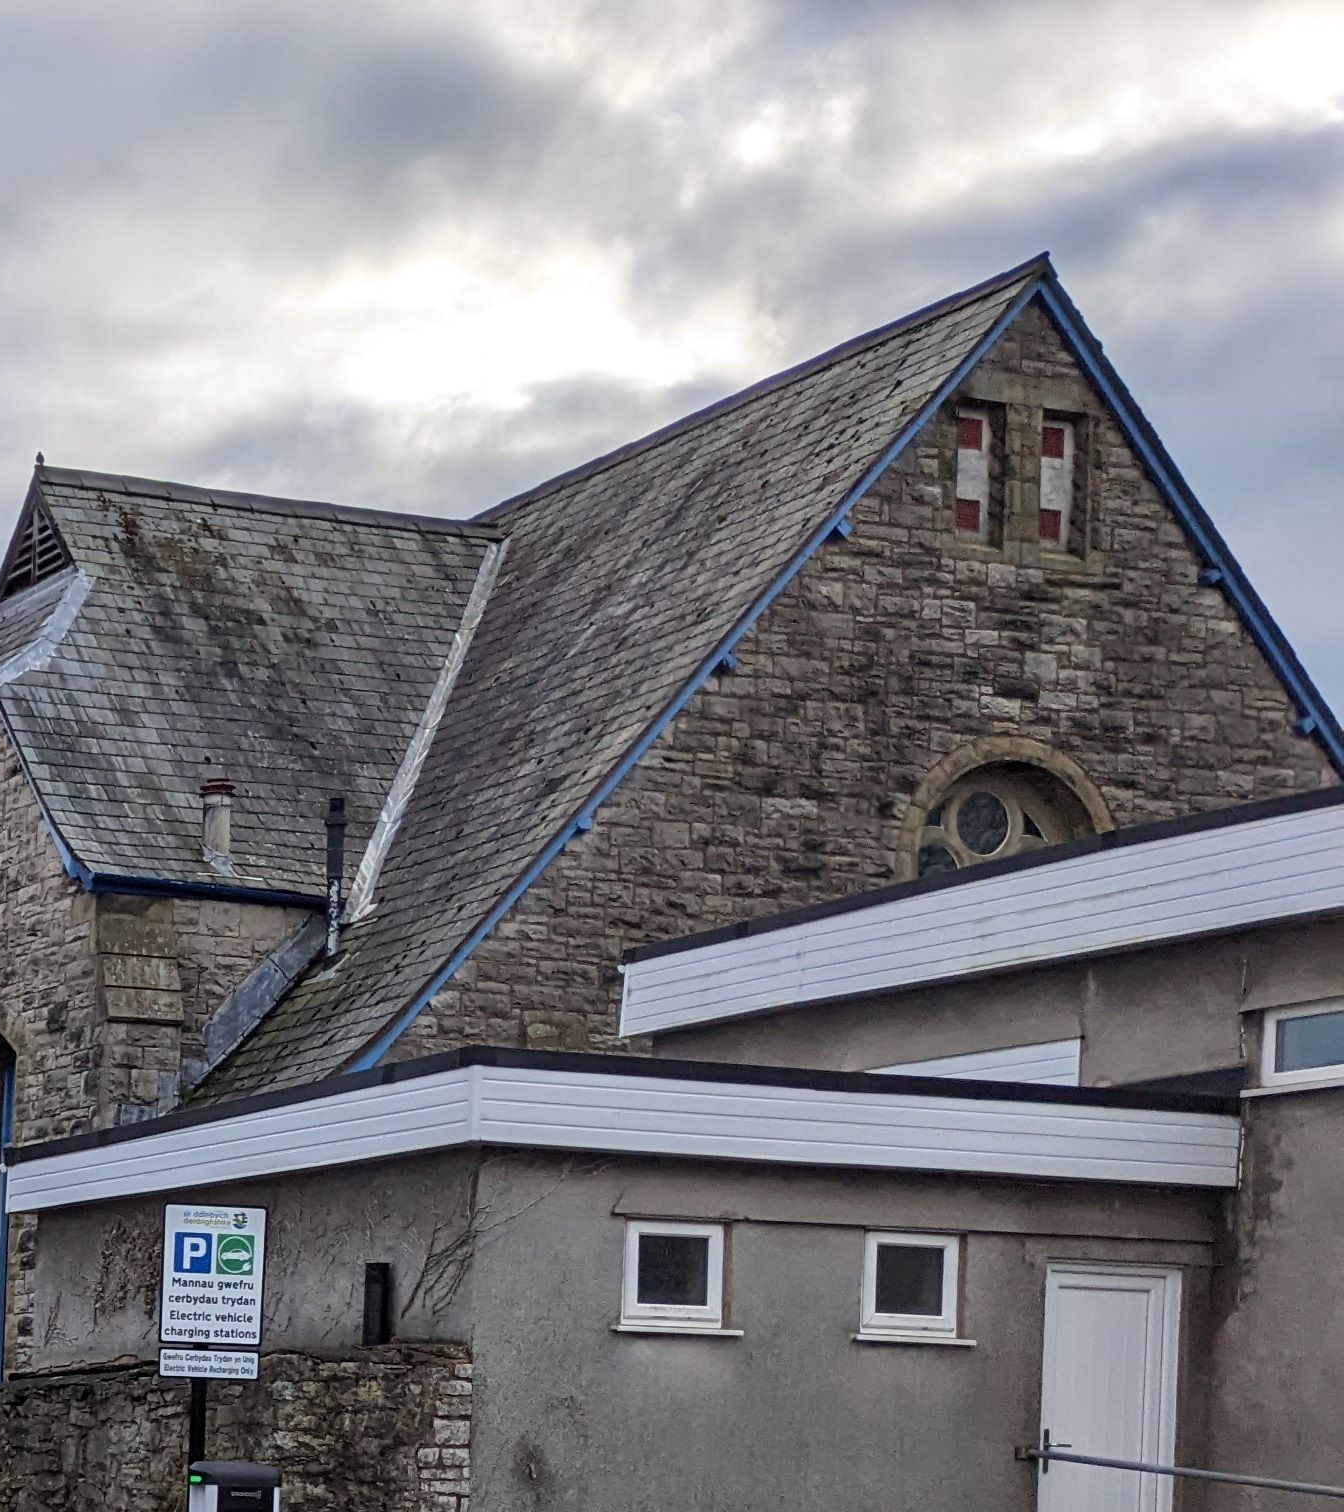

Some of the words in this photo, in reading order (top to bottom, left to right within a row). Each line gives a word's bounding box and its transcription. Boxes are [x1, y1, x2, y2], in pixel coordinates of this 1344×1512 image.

[182, 1237, 207, 1270] P
[171, 1277, 214, 1288] Mannau
[217, 1279, 254, 1291] gwefru
[168, 1294, 218, 1306] cerbydau
[221, 1295, 256, 1307] trydan
[169, 1310, 212, 1322] Electric
[214, 1312, 254, 1323] vehicle
[164, 1326, 211, 1339] charging
[213, 1328, 257, 1340] stations
[163, 1363, 185, 1372] Electric
[188, 1365, 208, 1373] Vehicle
[209, 1365, 240, 1375] Recharging
[240, 1367, 254, 1375] Only
